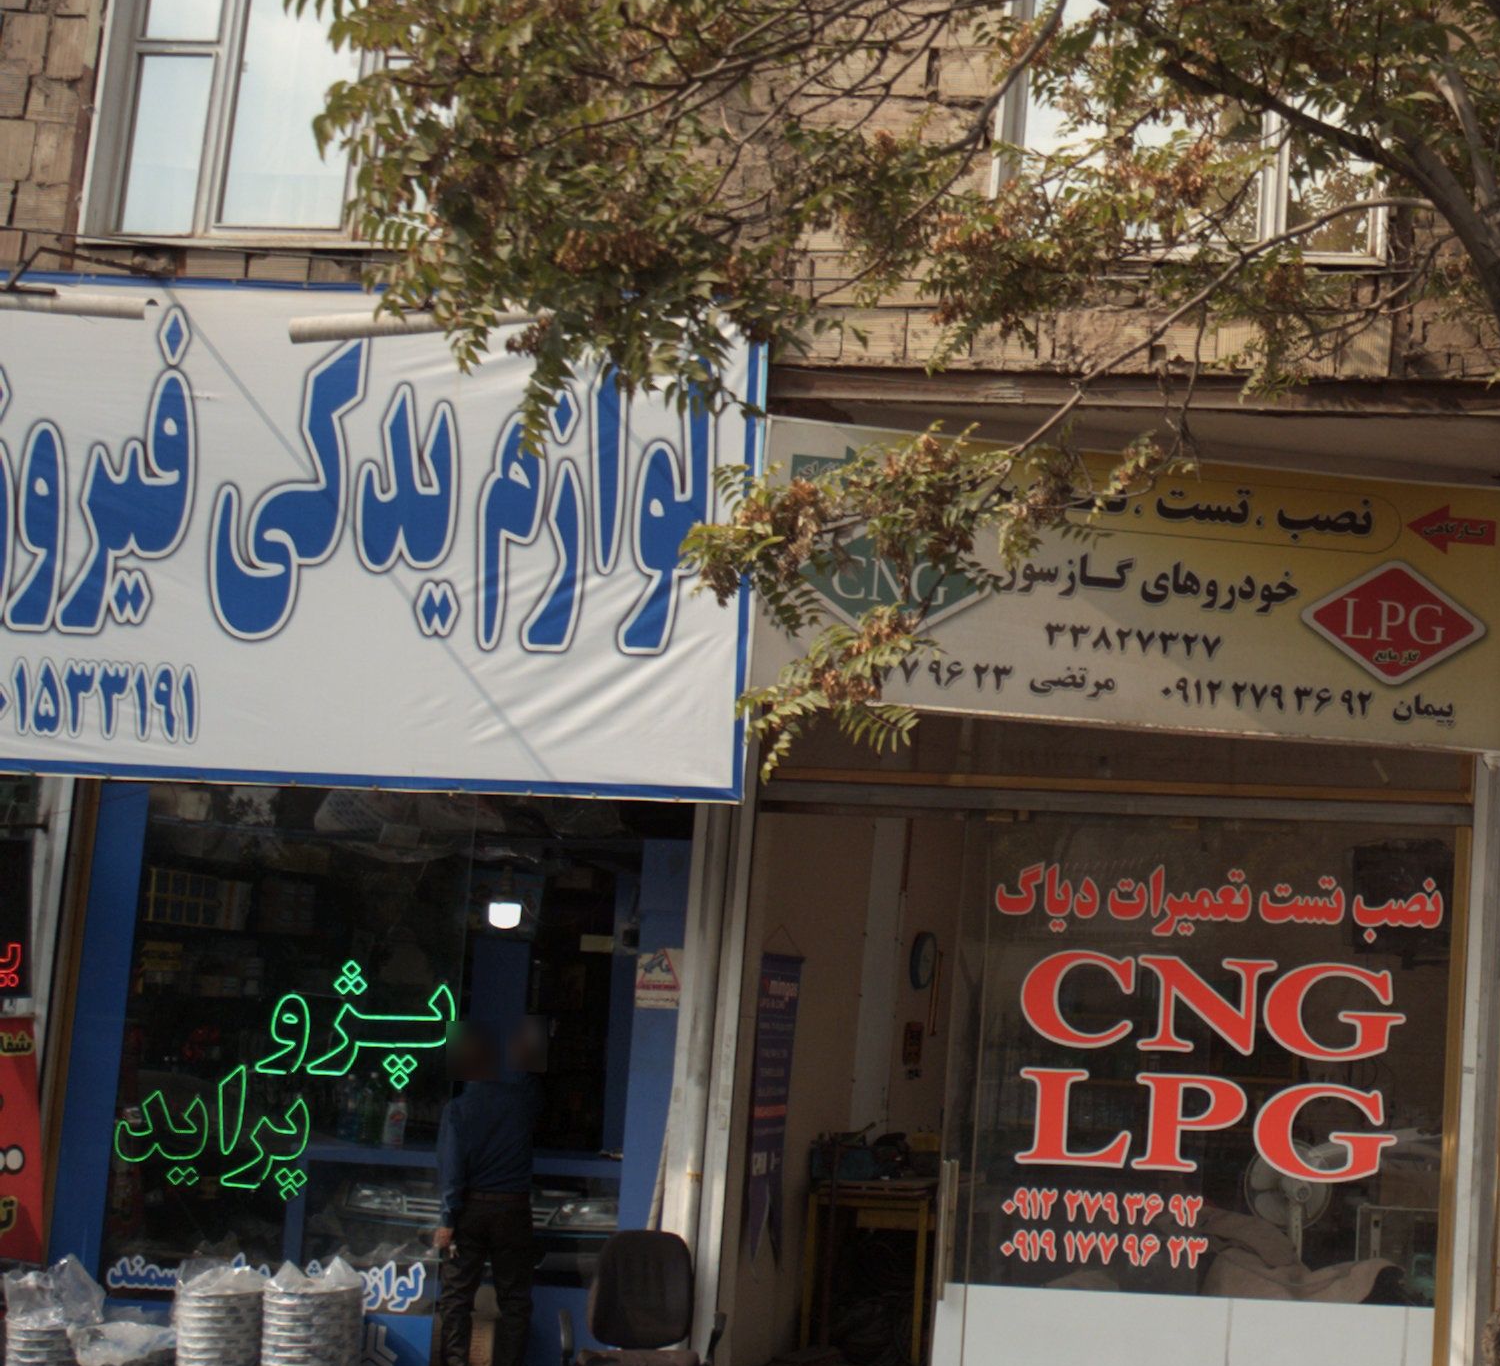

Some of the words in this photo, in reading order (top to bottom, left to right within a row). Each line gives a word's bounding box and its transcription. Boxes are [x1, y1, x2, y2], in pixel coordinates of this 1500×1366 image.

[0, 305, 197, 634] فیرو
[209, 333, 458, 639] یدکی
[477, 350, 716, 653] لوازم
[831, 554, 949, 607] CNG
[1140, 561, 1299, 614] خودروهای
[1341, 596, 1446, 645] LPG
[1029, 666, 1116, 699] مرتضی
[1392, 694, 1456, 725] پیمان
[995, 861, 1100, 933] دیاگ
[1107, 864, 1252, 937] تعمیرات
[1258, 874, 1346, 927] تست
[1353, 876, 1444, 944] نصب
[254, 959, 457, 1091] پژو
[1019, 949, 1407, 1062] CNG
[114, 1064, 311, 1201] پراید
[1014, 1067, 1399, 1184] LPG
